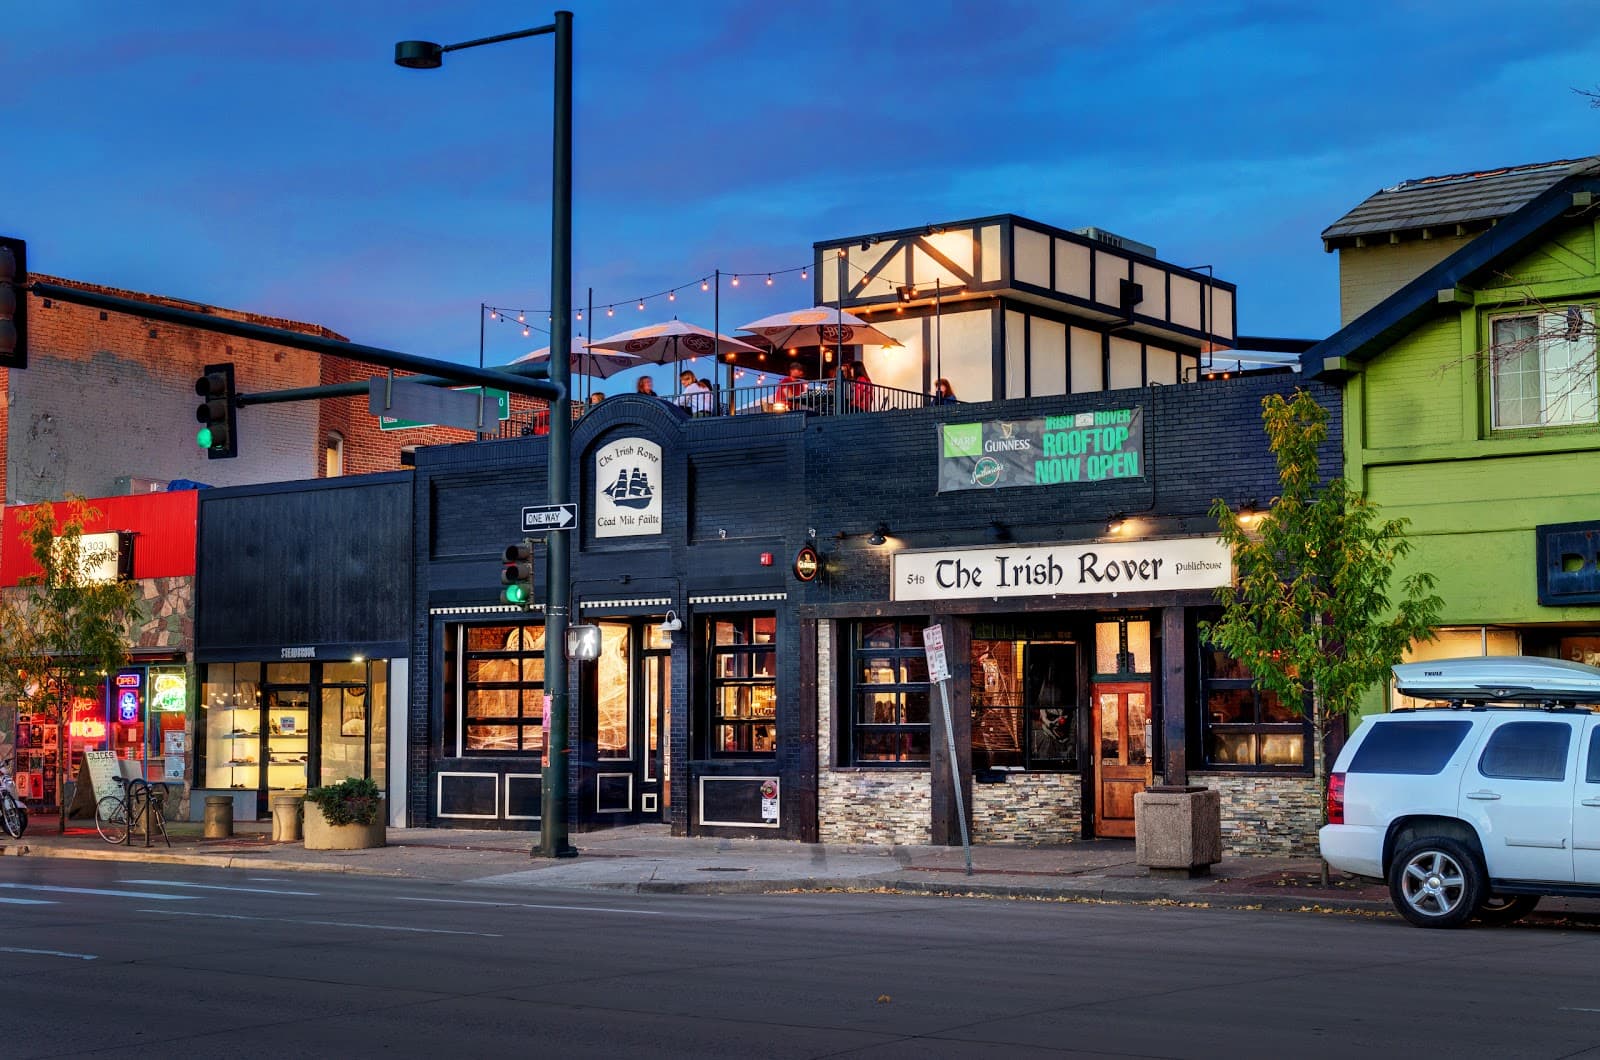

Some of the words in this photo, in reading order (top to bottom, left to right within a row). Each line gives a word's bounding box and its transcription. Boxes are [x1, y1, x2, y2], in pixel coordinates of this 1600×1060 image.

[1045, 415, 1074, 431] IRISH
[1095, 409, 1131, 426] ROVER
[984, 439, 1031, 453] GUINNESS
[1043, 426, 1129, 457] ROOFTOP
[599, 454, 613, 467] The
[615, 445, 634, 458] Irish
[637, 446, 659, 464] Rover
[1035, 458, 1081, 485] NOW
[1087, 452, 1138, 481] OPEN
[527, 515, 543, 524] ONE
[545, 512, 560, 522] WAY
[935, 558, 983, 590] The
[996, 553, 1064, 588] Irish
[1078, 551, 1164, 584] Rover
[116, 676, 137, 686] OPEN
[88, 751, 114, 760] SLICES
